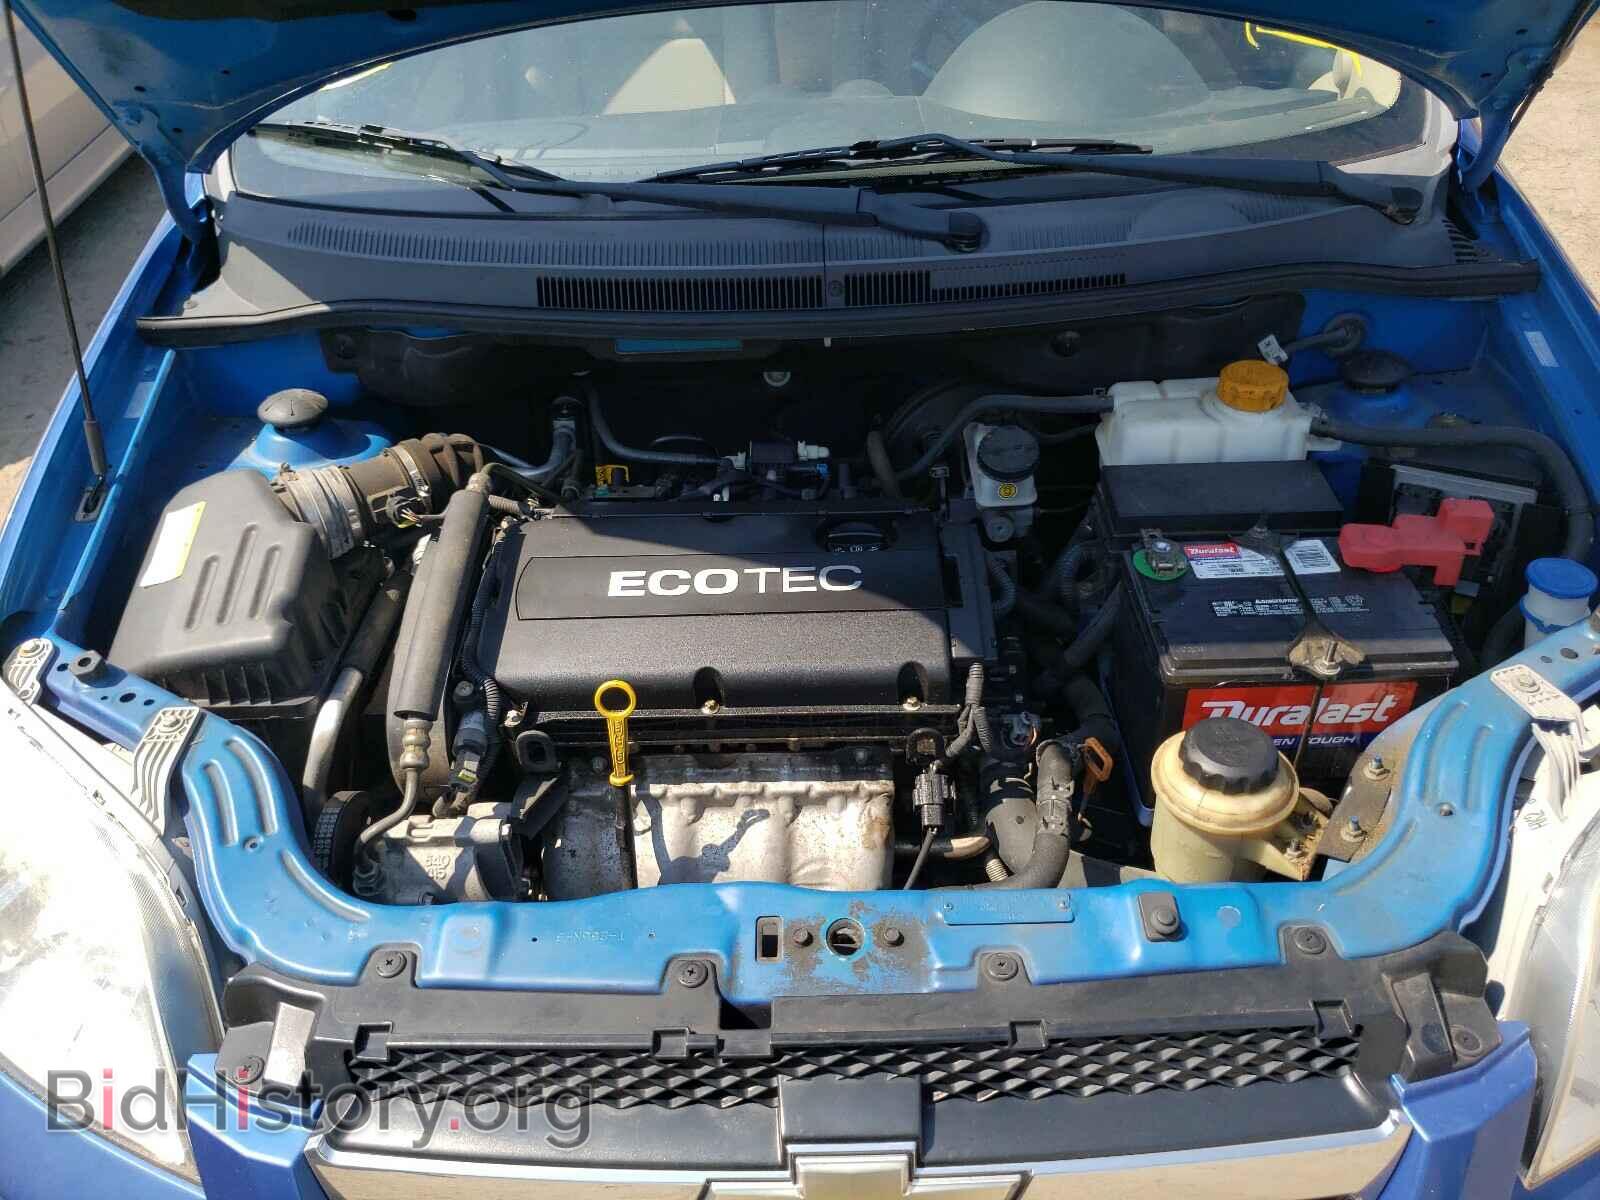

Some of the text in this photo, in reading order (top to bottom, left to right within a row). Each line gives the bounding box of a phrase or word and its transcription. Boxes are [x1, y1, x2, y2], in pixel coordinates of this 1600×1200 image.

[1189, 545, 1236, 555] Duralast
[608, 565, 862, 596] ECOTEC
[1201, 694, 1398, 727] Duralast
